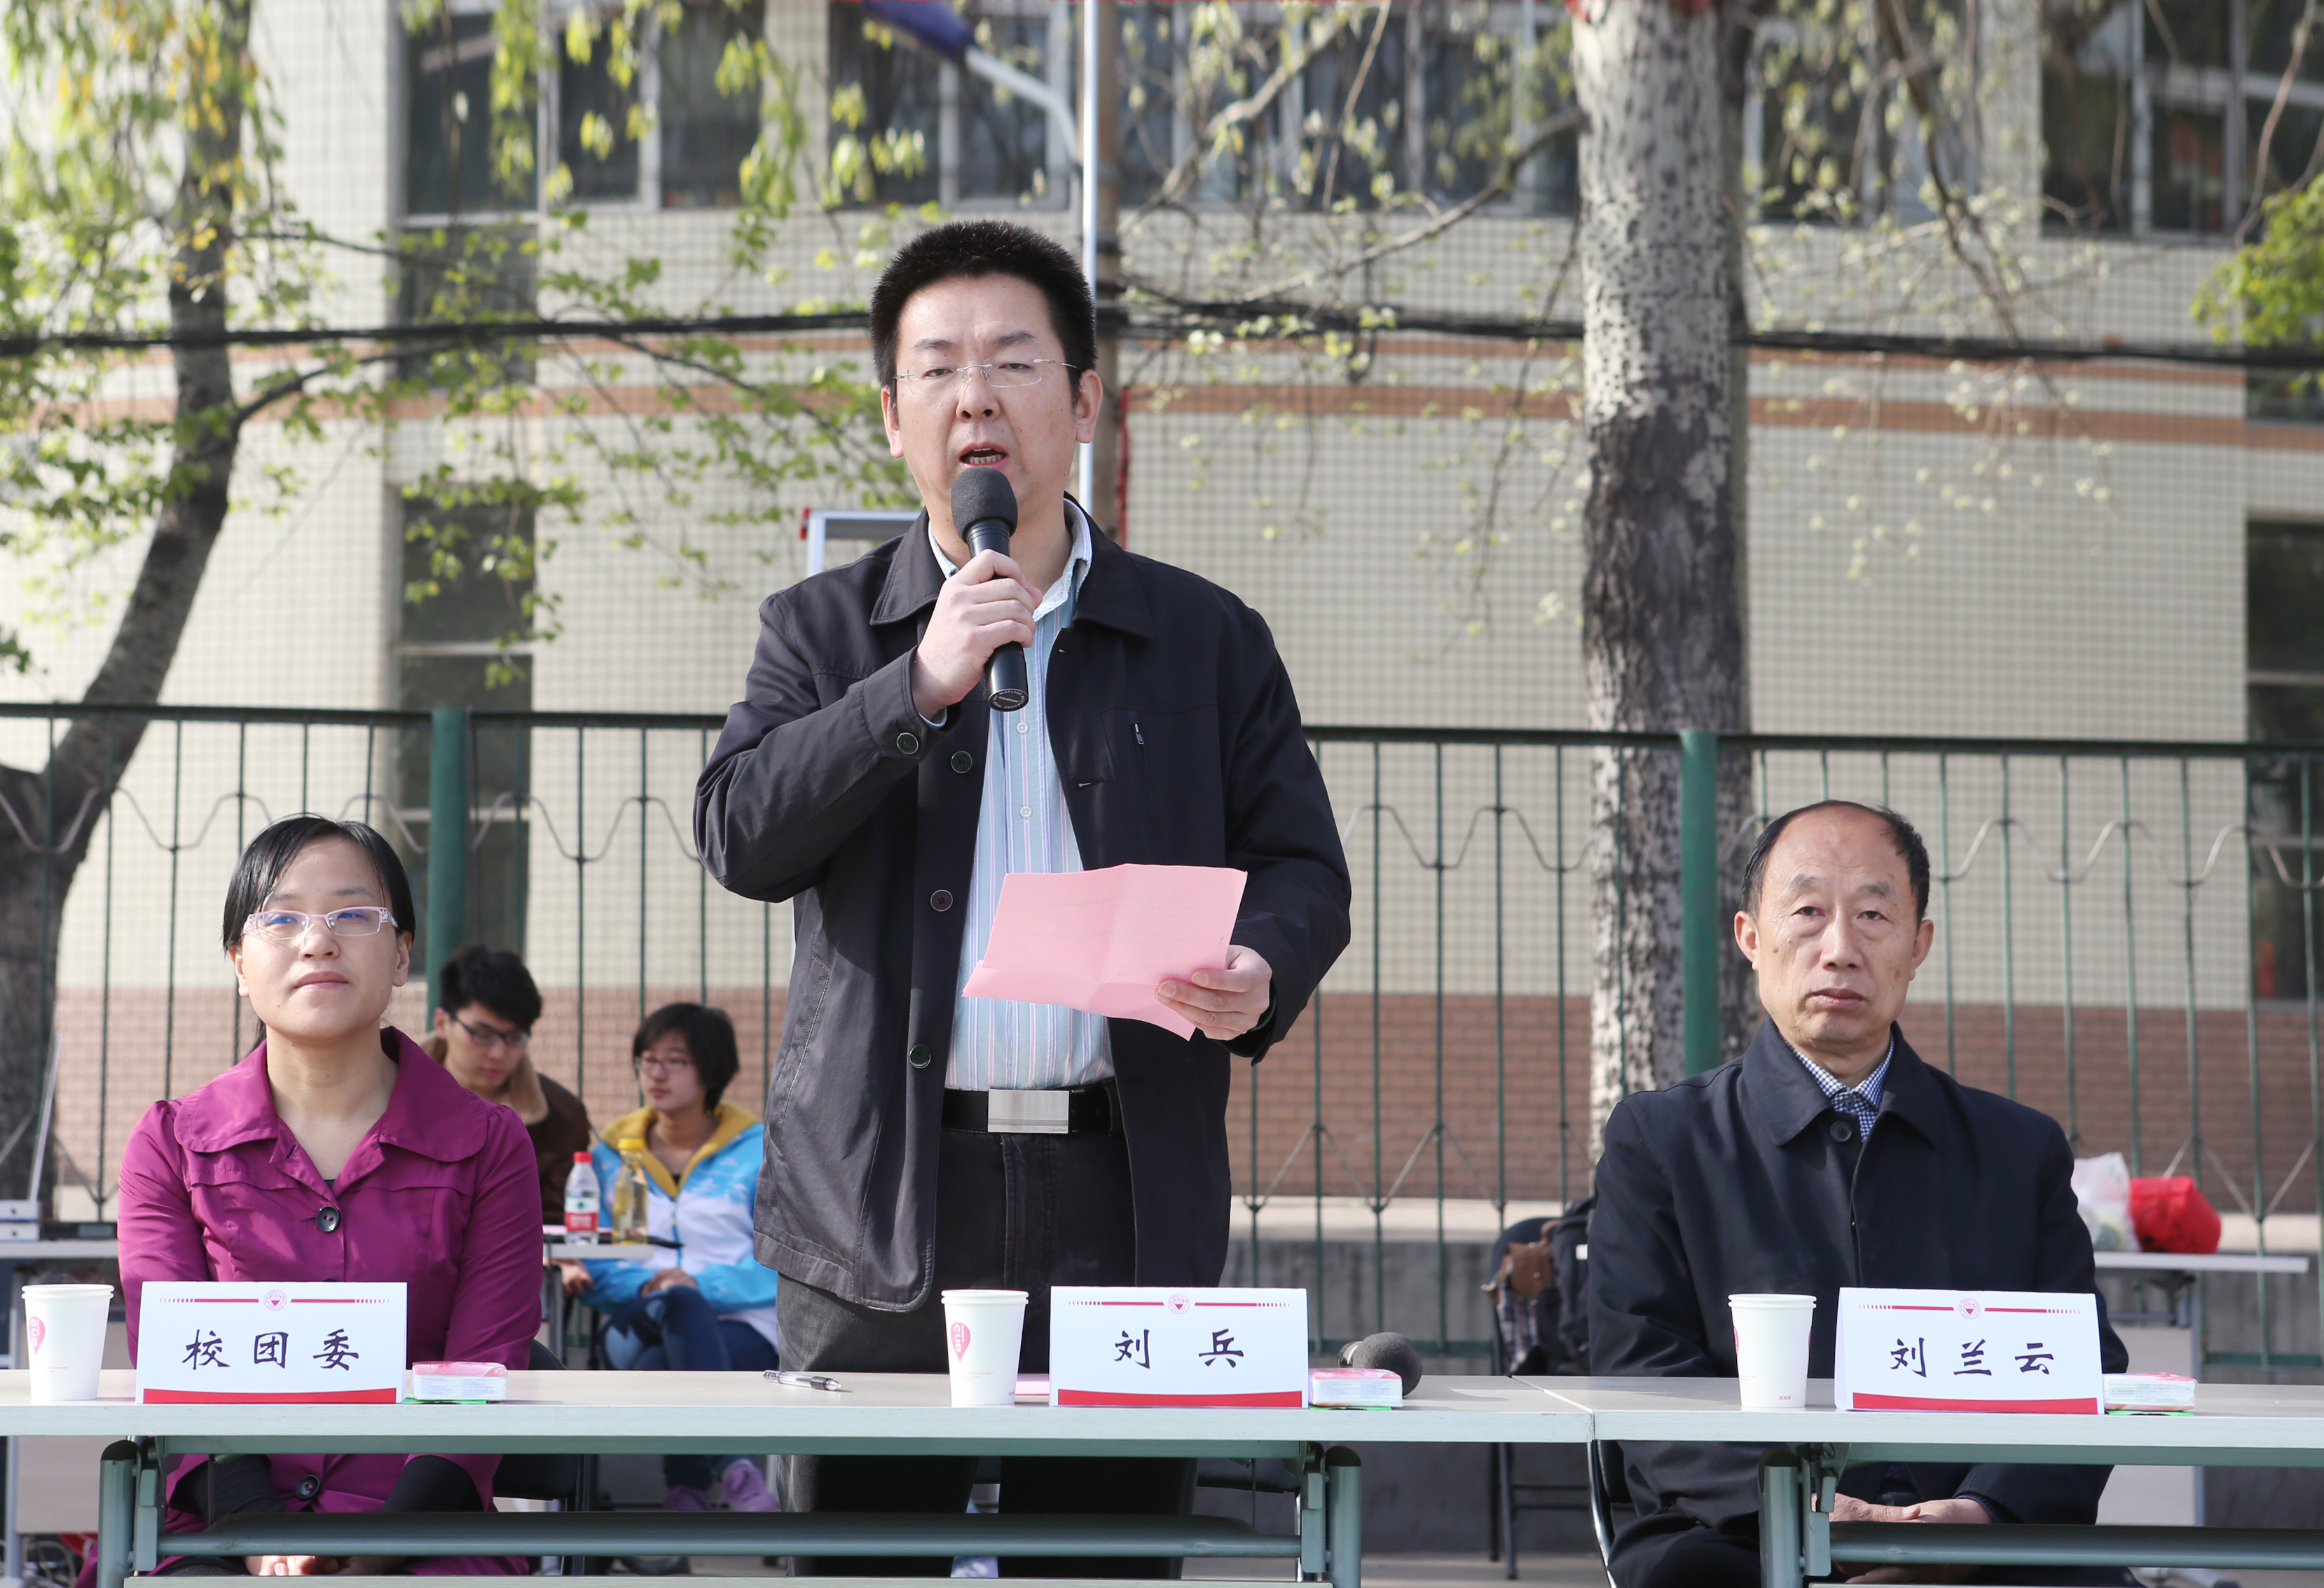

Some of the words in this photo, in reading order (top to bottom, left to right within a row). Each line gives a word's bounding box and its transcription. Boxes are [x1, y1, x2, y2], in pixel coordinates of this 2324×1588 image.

[181, 1329, 359, 1371] 校团委
[1113, 1329, 1244, 1369] 刘兵
[1890, 1336, 2054, 1378] 刘兰云
